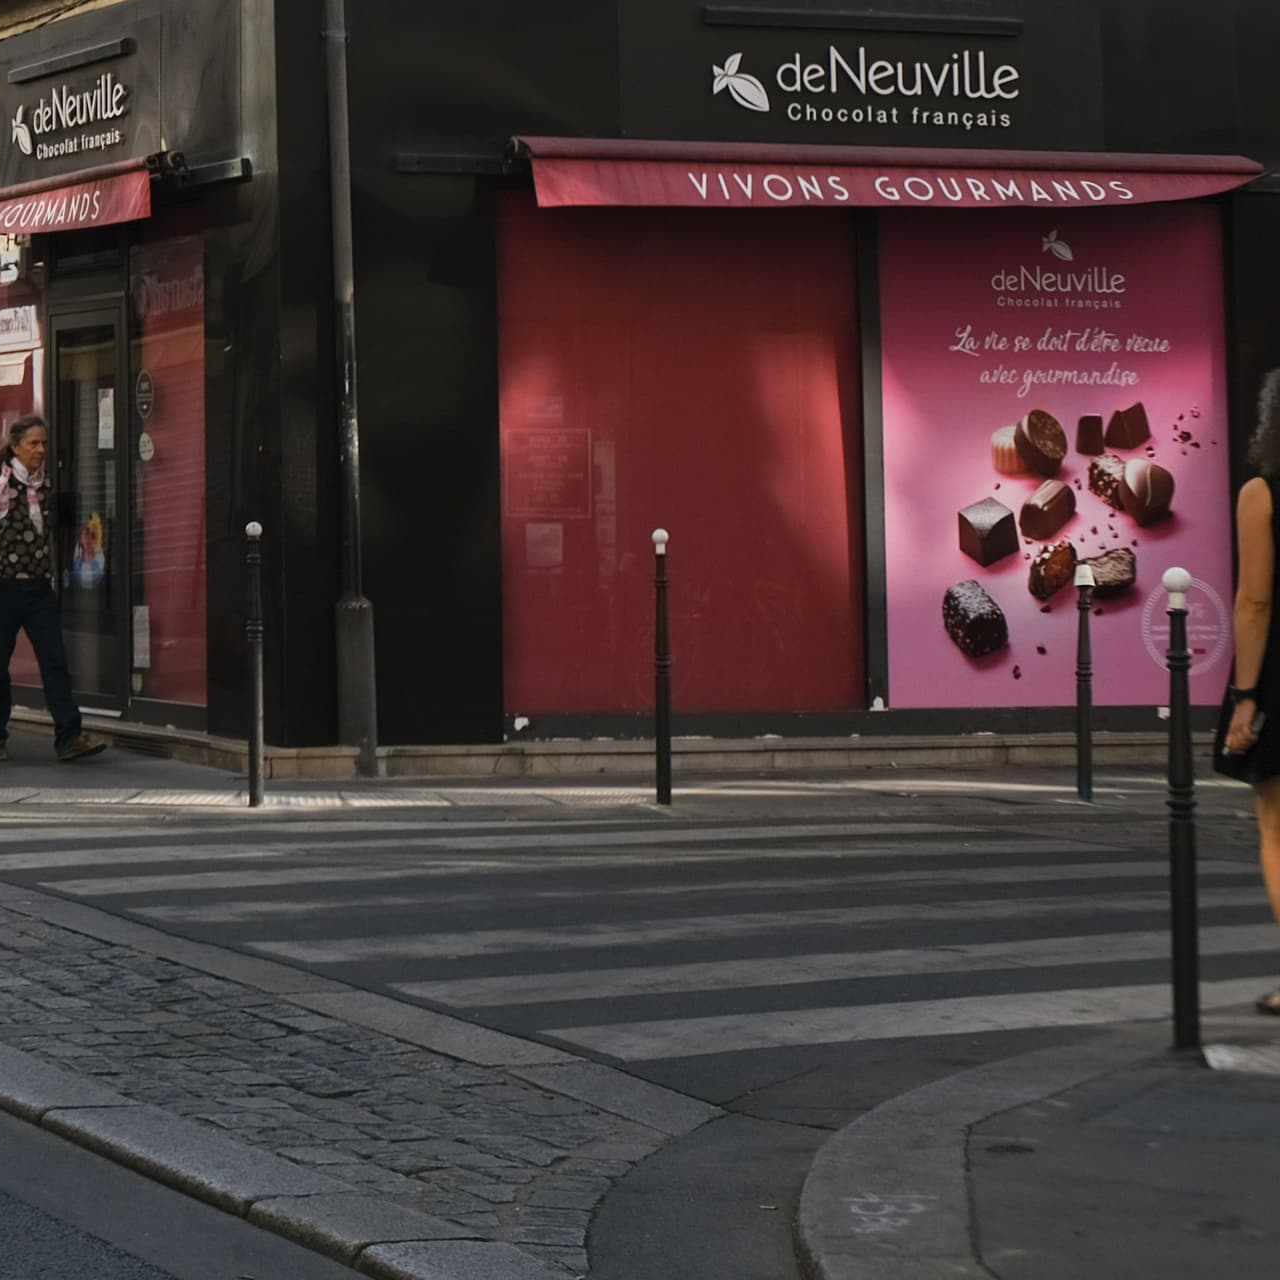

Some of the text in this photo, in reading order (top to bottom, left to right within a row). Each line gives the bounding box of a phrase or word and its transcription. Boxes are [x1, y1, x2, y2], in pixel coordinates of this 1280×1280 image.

[776, 45, 1020, 99] deNeuville
[33, 72, 125, 135] deNeuville
[787, 103, 1011, 130] Chocolat français
[36, 129, 121, 160] Chocolat français
[688, 172, 1134, 201] VIVONS GOURMANDS
[991, 265, 1126, 293] deNeuville
[997, 296, 1121, 309] Chocolat français
[948, 324, 980, 357] La
[985, 331, 1009, 351] vie
[1014, 335, 1032, 352] se
[1037, 328, 1080, 352] doit
[980, 362, 1140, 398] avec gourmandise
